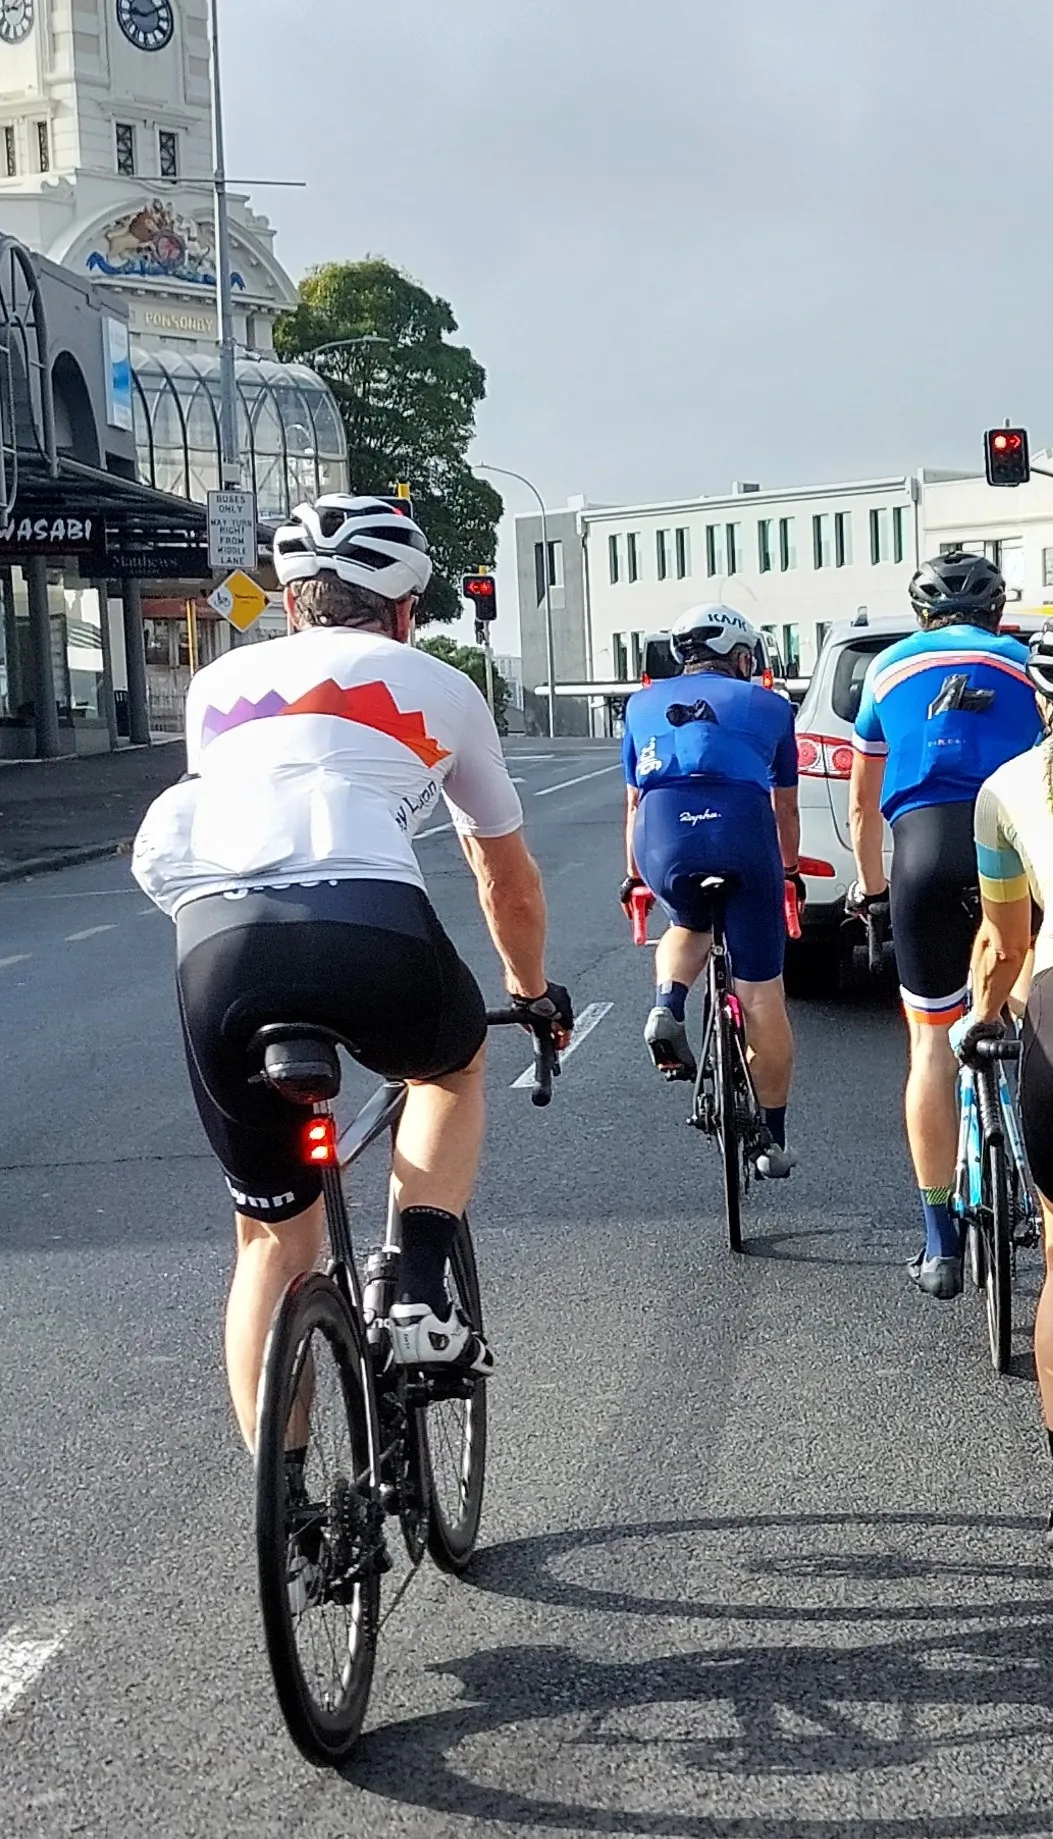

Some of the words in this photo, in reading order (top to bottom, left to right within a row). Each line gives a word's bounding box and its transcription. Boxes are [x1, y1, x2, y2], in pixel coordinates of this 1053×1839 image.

[145, 311, 213, 332] PONSONBY
[216, 494, 246, 504] BUSES
[219, 505, 244, 514] ONLY
[211, 519, 227, 527] MAY
[232, 519, 252, 527] TURN
[0, 517, 92, 542] WASABI
[220, 527, 245, 535] RIGHT
[220, 536, 245, 545] FROM
[217, 546, 247, 555] MIDDLE
[220, 556, 245, 565] LANE
[707, 613, 748, 633] KASK
